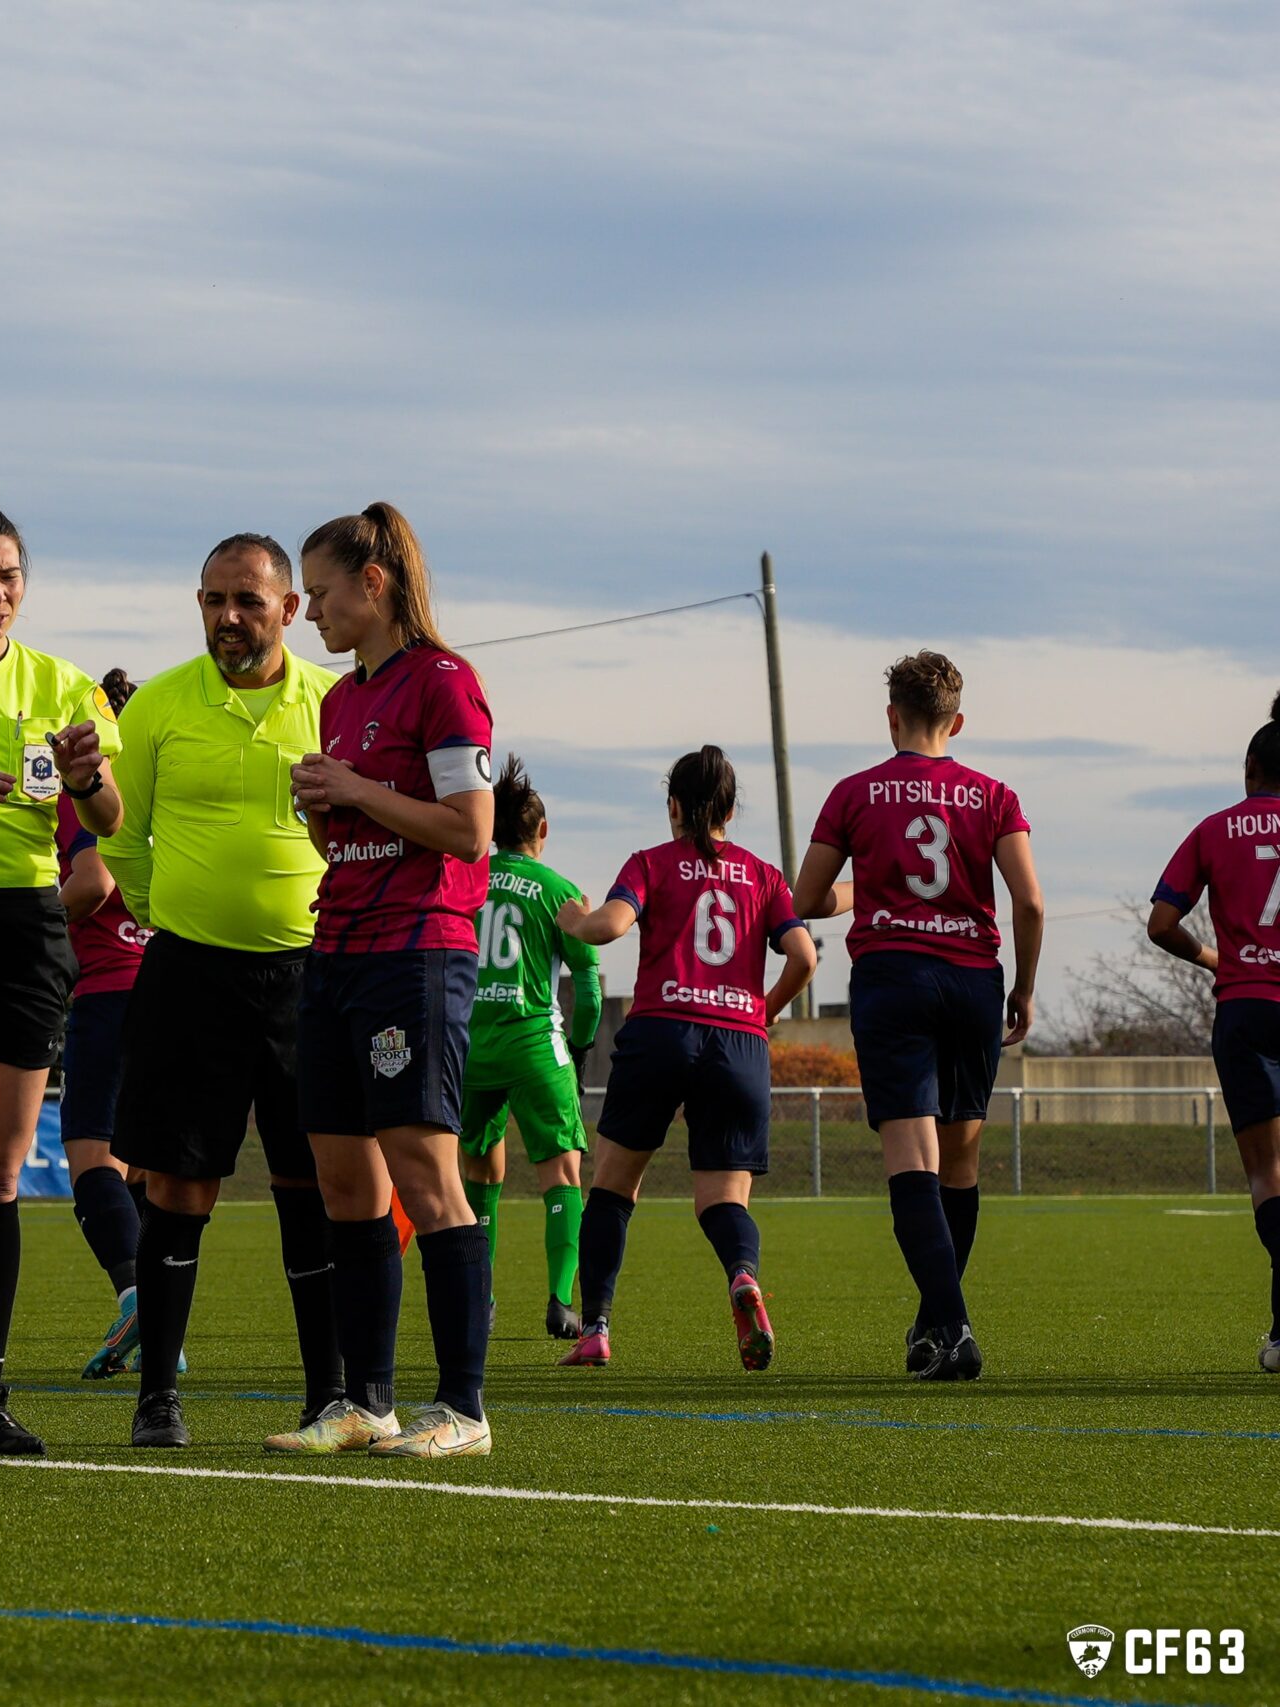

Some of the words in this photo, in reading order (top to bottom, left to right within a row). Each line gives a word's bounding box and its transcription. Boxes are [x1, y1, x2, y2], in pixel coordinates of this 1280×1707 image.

[869, 780, 983, 810] PITSILLOS
[343, 838, 404, 863] Mutuel
[905, 814, 950, 900] 3
[678, 859, 754, 886] SALTEL
[1255, 844, 1280, 926] 7
[478, 899, 524, 970] 16
[693, 889, 737, 967] 6
[661, 980, 754, 1014] Coudert
[373, 1049, 409, 1062] SPORT
